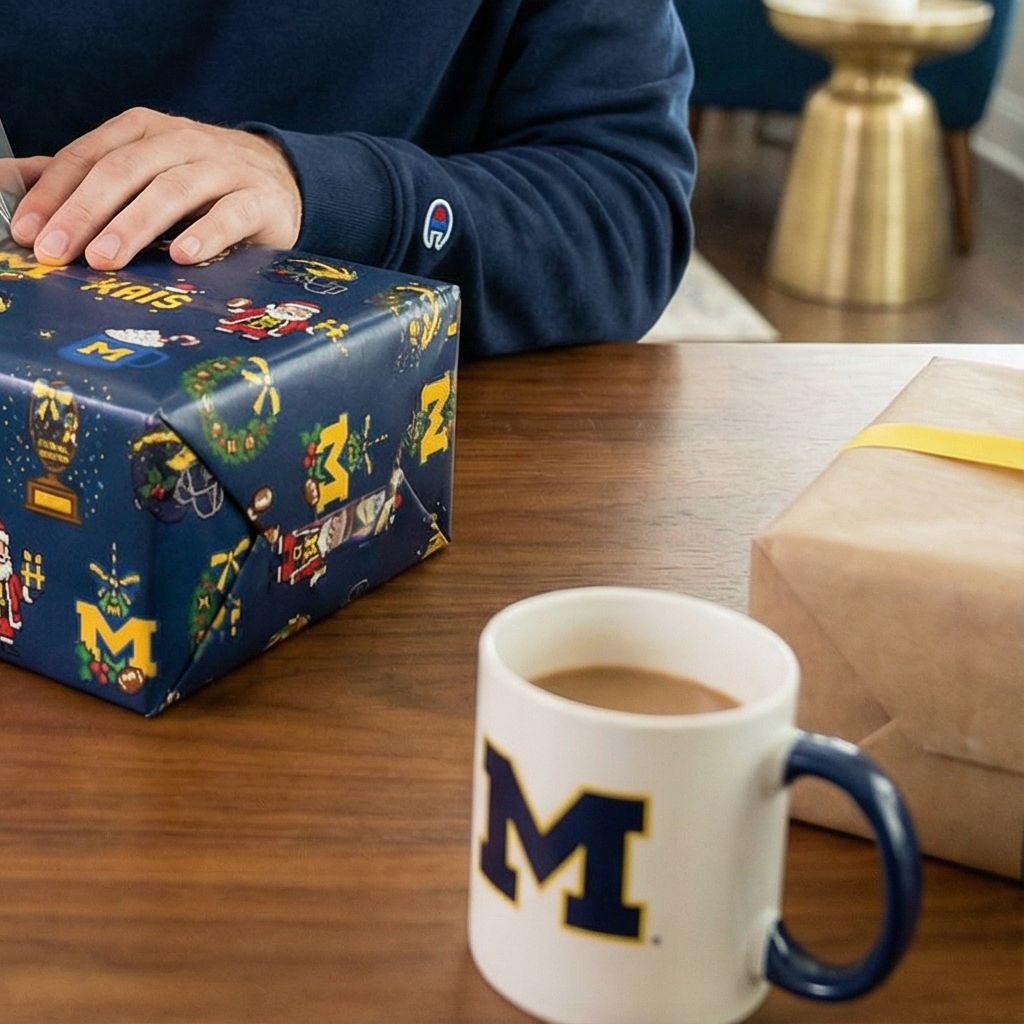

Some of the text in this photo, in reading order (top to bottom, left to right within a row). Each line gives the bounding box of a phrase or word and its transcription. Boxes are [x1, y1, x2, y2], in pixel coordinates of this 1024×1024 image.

[76, 340, 135, 362] M
[76, 599, 158, 679] M
[478, 736, 652, 946] M
